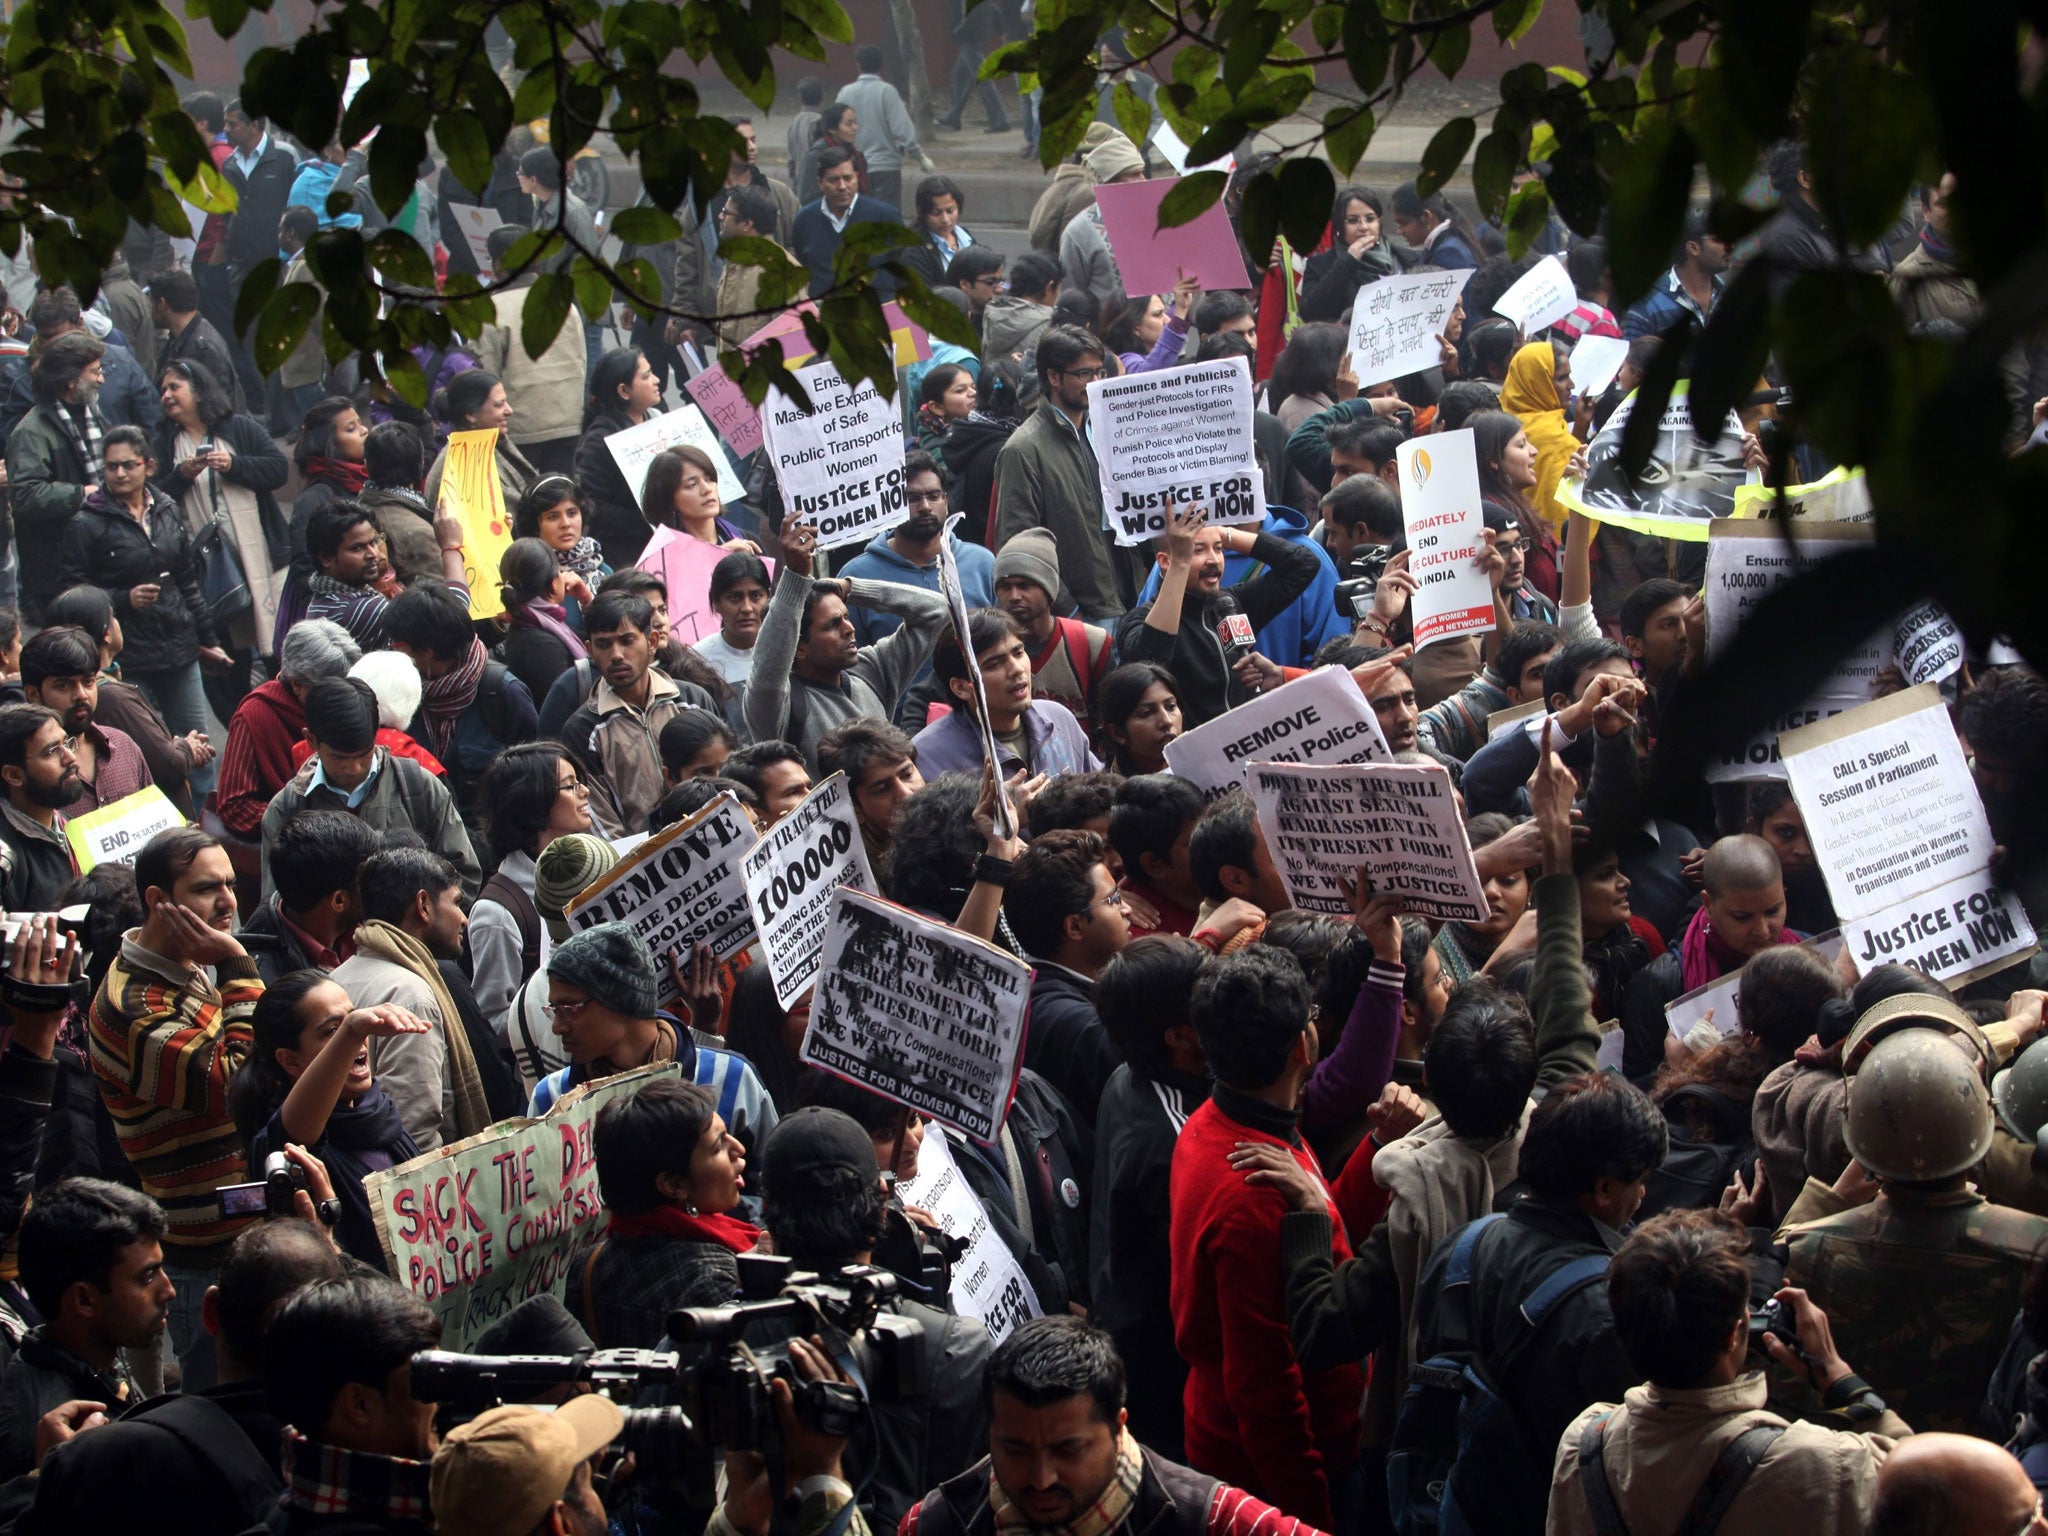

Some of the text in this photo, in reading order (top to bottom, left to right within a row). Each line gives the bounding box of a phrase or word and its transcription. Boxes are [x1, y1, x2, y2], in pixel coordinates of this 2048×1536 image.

[1102, 368, 1237, 398] Announce and Publicise
[1155, 390, 1193, 404] Protocols
[1195, 388, 1210, 398] for
[1211, 384, 1234, 395] FIRs
[823, 411, 869, 434] of Safe
[1114, 411, 1236, 439] of Crimes against Women!
[1116, 399, 1232, 424] and Police Investigation
[781, 425, 889, 468] Public Transport
[1112, 427, 1242, 455] Punish Police who Violate the
[1132, 442, 1228, 465] Protocols and Display
[826, 453, 878, 477] Women
[1112, 452, 1249, 482] Gender Bias or Victim Blaming!
[1210, 477, 1252, 498] FOR
[1214, 494, 1255, 520] NOW
[1419, 536, 1438, 549] END
[1421, 547, 1476, 568] CULTURE
[1745, 555, 1793, 567] Ensure
[1425, 569, 1456, 586] INDIA
[1721, 572, 1767, 592] 1,00,000
[1439, 610, 1468, 622] WOMEN
[1446, 617, 1487, 632] NETWORK
[1222, 705, 1321, 764] REMOVE
[1301, 718, 1370, 758] Police
[1833, 741, 1911, 779] CALL a Special
[1307, 776, 1352, 794] PASS
[1356, 777, 1396, 795] THE
[1398, 781, 1442, 798] BILL
[1819, 753, 1939, 807] Session of Parliament
[1280, 798, 1429, 818] AGAINST SEXUAL
[100, 830, 130, 853] END
[745, 781, 840, 881] FAST TRACK THE
[1278, 817, 1439, 838] HARRASSMENT IN
[1277, 836, 1454, 860] ITS PRESENT FORM!
[1846, 828, 1968, 883] in Consultation with Women's
[574, 807, 742, 931] REMOVE
[757, 820, 852, 927] 100000
[1285, 857, 1302, 870] No
[1364, 862, 1459, 879] Compensations!
[1854, 843, 1970, 896] Organisations and Students
[664, 861, 731, 916] DELHI
[1287, 874, 1469, 897] WE JUSTICE!
[768, 902, 808, 949] PENDING
[808, 884, 833, 913] RAPE
[1297, 895, 1476, 919] JUSTICE NOW
[1953, 887, 2001, 924] FOR
[772, 929, 804, 966] ACROSS
[804, 911, 825, 938] THE
[1966, 909, 2018, 954] NOW
[779, 961, 813, 999] JUSTICE
[982, 960, 1019, 996] BILL
[862, 985, 1002, 1063] PRESENT FORM!
[981, 1015, 1001, 1036] IN
[817, 1015, 847, 1042] WE
[912, 1059, 995, 1109] JUSTICE!
[847, 1009, 901, 1046] Monetary
[905, 1032, 996, 1086] Compensations!
[810, 1043, 990, 1136] JUSTICE FOR WOMEN NOW
[393, 1145, 540, 1246] SACK THE
[962, 1260, 990, 1298] Women
[1000, 1276, 1022, 1316] FOR
